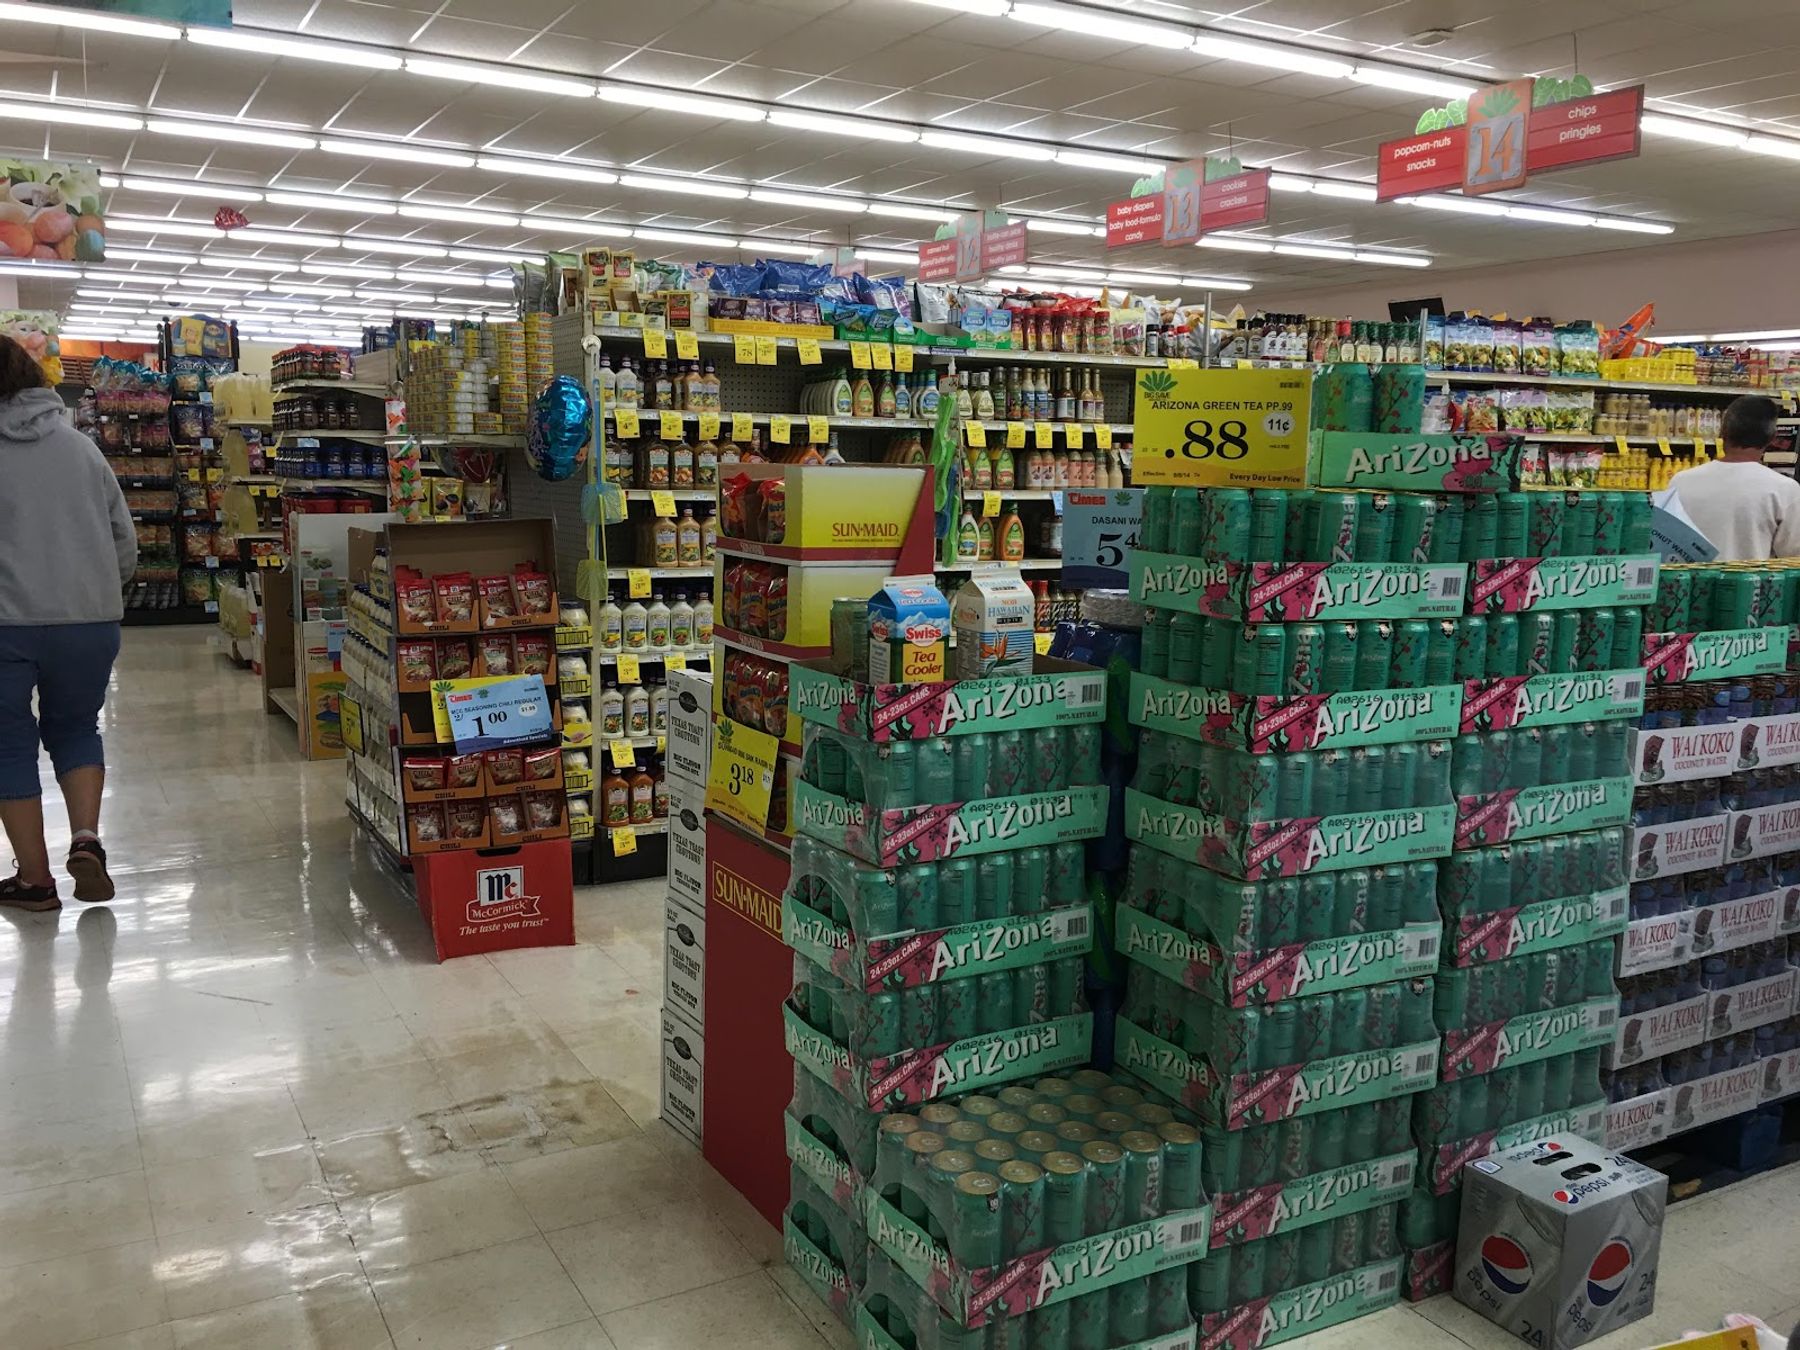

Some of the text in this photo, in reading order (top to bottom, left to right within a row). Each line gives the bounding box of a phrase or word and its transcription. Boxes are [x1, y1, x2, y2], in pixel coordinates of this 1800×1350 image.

[1568, 104, 1597, 120] chips
[1559, 123, 1602, 142] pringles
[1406, 157, 1436, 172] snacks
[1475, 122, 1515, 177] 14
[1221, 180, 1247, 192] cookies
[1117, 206, 1132, 216] baby
[1168, 191, 1194, 234] 13
[1220, 196, 1247, 208] crackers
[1109, 220, 1124, 230] baby
[1125, 231, 1144, 242] candy
[1152, 401, 1293, 411] ARIZONA GREEN TEA PP.99
[1165, 420, 1249, 460] .88
[1267, 418, 1290, 434] 11¢
[1345, 441, 1490, 483] AriZona
[1229, 472, 1301, 483] Every Day Low Price
[1092, 516, 1127, 524] DASANI
[1125, 532, 1141, 548] 4
[1141, 563, 1228, 600] AriZona
[906, 627, 942, 642] Swiss
[905, 664, 942, 676] Cooler
[913, 651, 936, 663] Tea
[1682, 633, 1767, 681] AriZona
[796, 681, 857, 711] AriZona
[1142, 689, 1232, 721] AriZona
[1311, 693, 1432, 748] AriZona
[1766, 722, 1791, 746] WAI
[1672, 730, 1734, 759] WAI KOKO
[803, 797, 864, 826] AriZona
[1138, 807, 1225, 841] AriZona
[1504, 785, 1606, 840] AriZona
[943, 797, 1072, 857] AriZona
[1304, 812, 1424, 871] AriZona
[1665, 823, 1723, 854] WAI KOKO
[472, 900, 527, 919] McCormick
[1720, 898, 1775, 928] WAI KOKO
[459, 926, 477, 936] The
[479, 923, 501, 933] taste
[502, 920, 520, 932] you
[791, 914, 850, 950] AriZona
[1629, 921, 1677, 949] WAI KOKO
[1128, 923, 1211, 965] AriZona
[1760, 979, 1791, 1003] KOKO
[1650, 1003, 1706, 1037] WAI KOKO
[790, 1028, 850, 1069] AriZona
[929, 1027, 1058, 1098] AriZona
[1127, 1037, 1209, 1085] AriZona
[1724, 1069, 1758, 1096] KOKO
[1606, 1102, 1654, 1132] WAI KOKO
[794, 1142, 851, 1187] AriZona
[1573, 1178, 1609, 1199] pepsi
[877, 1213, 949, 1277] AriZona
[790, 1237, 846, 1292] AriZona
[1467, 1269, 1503, 1311] pepsi
[1567, 1302, 1595, 1333] pepsi
[1521, 1320, 1545, 1348] 24
